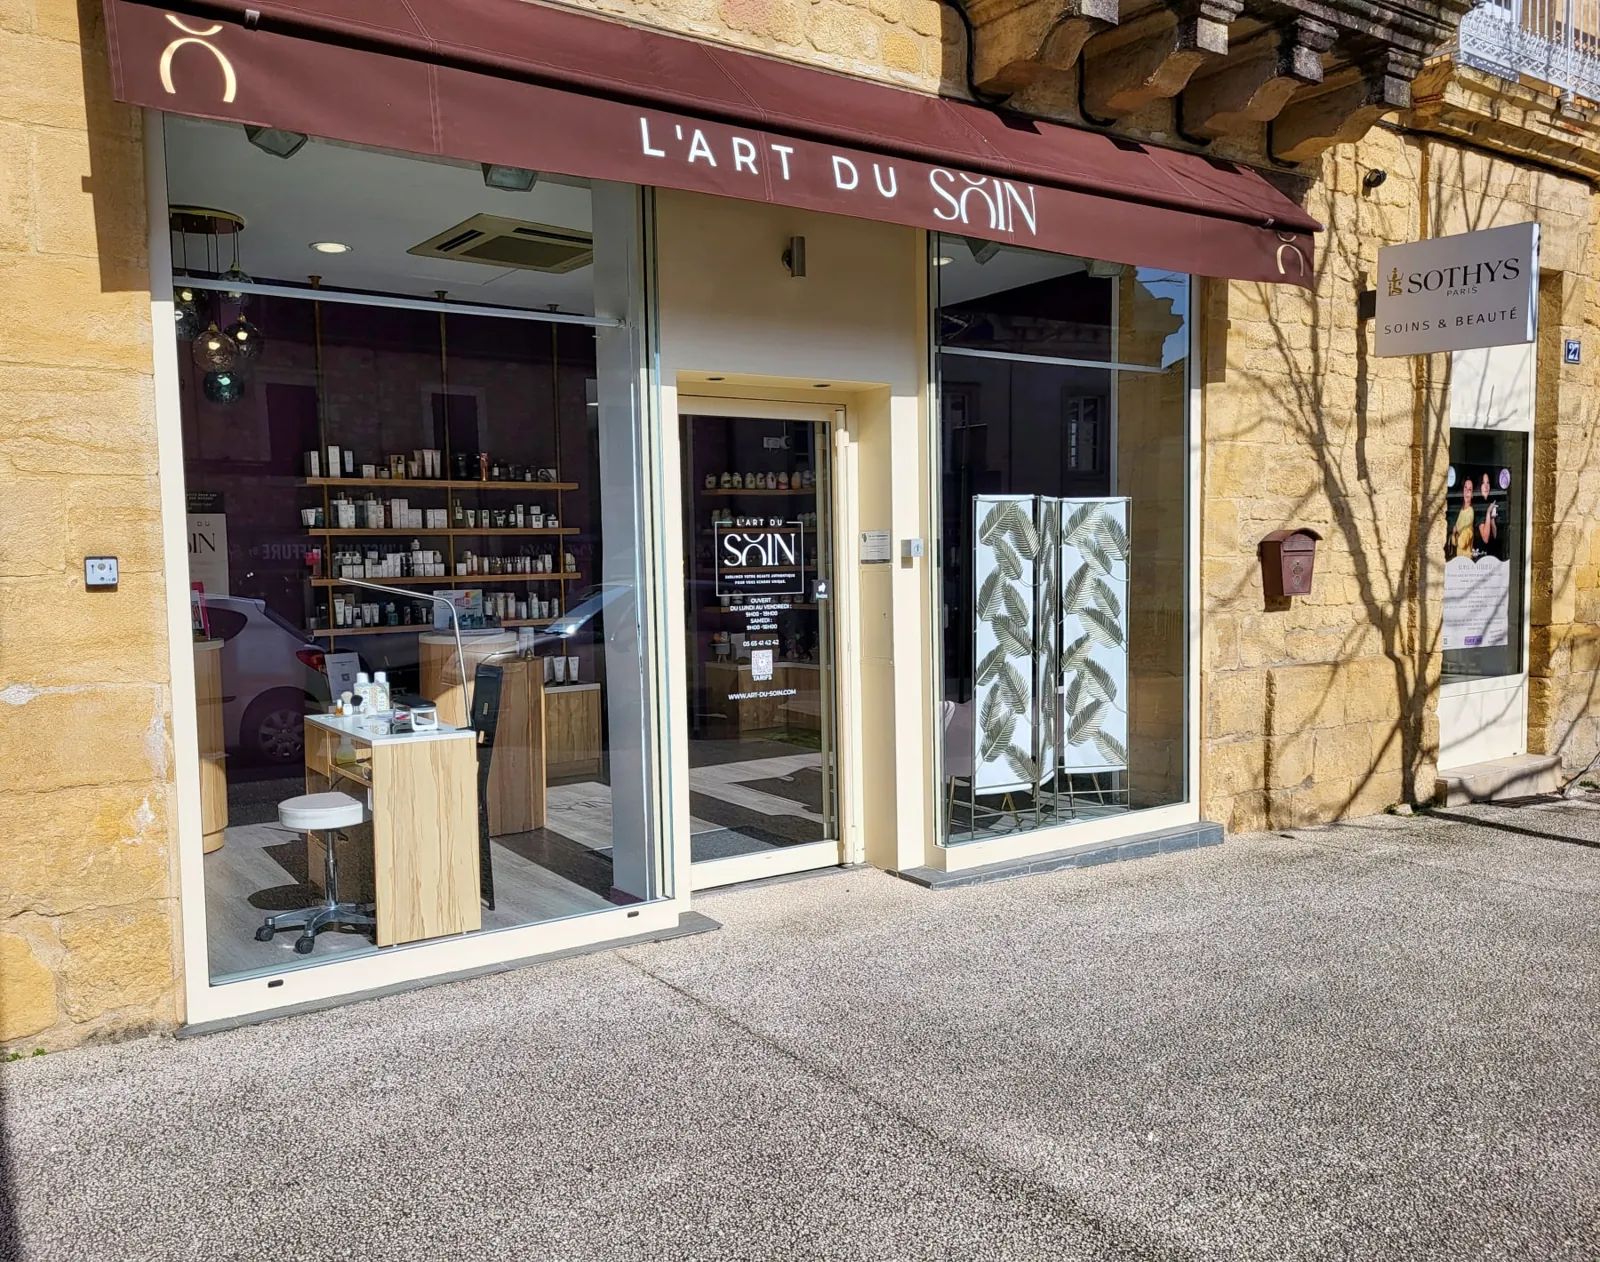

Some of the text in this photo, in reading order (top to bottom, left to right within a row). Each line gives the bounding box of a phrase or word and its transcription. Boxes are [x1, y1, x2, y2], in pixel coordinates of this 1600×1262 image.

[640, 117, 1037, 236] L'ART DU SOIN
[1407, 257, 1520, 294] SOTHYS
[1446, 286, 1478, 297] PARIS
[1384, 306, 1518, 335] SOINS & BEAUTÉ
[1568, 342, 1579, 360] 27
[723, 533, 796, 567] SOIN
[728, 688, 797, 700] WWW.ART-DU-SOIN.COM
